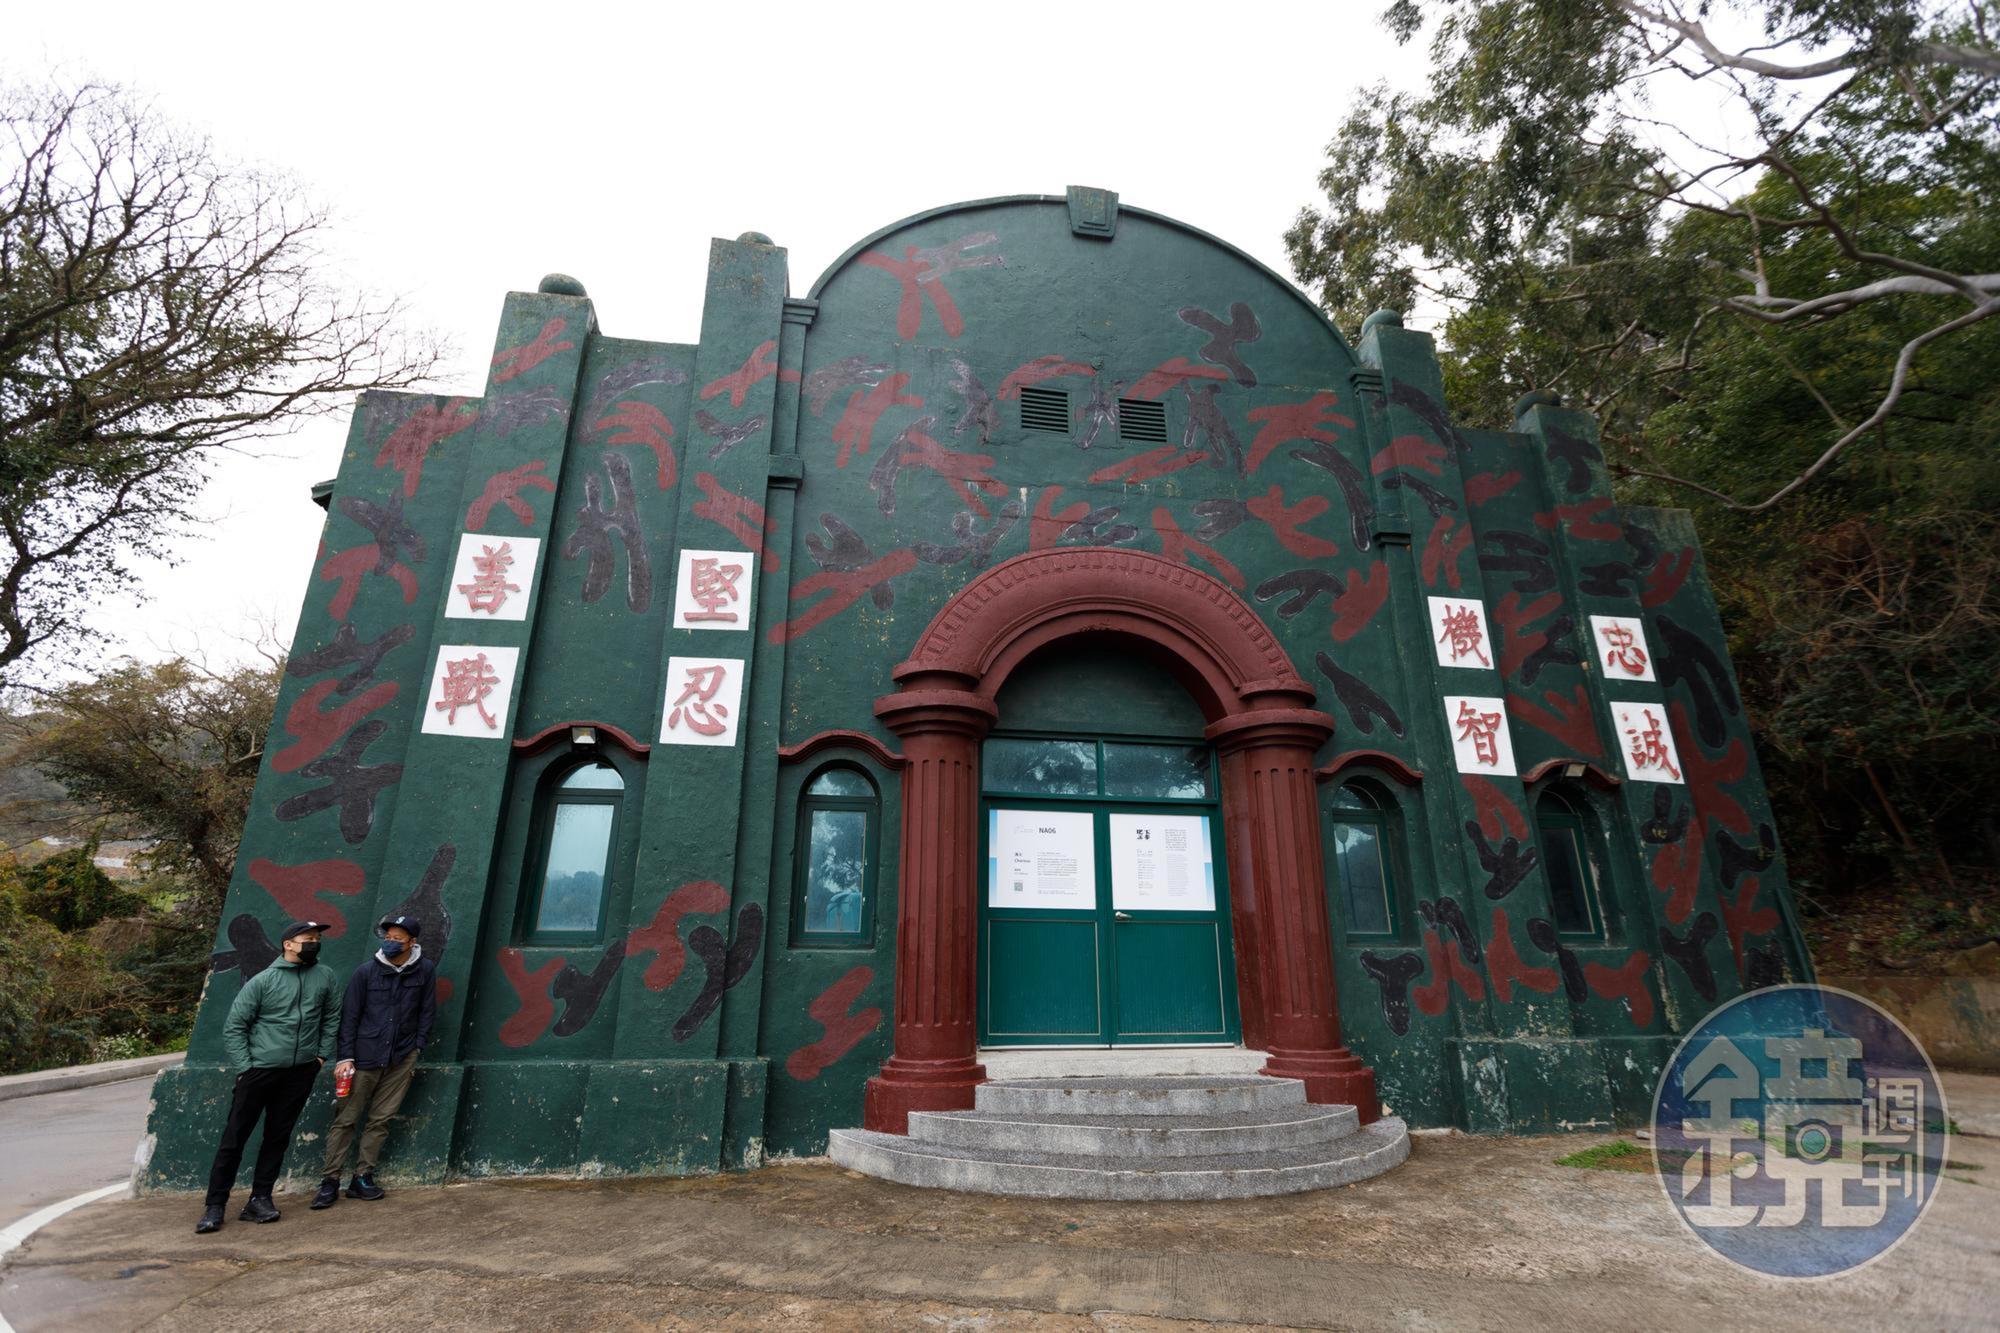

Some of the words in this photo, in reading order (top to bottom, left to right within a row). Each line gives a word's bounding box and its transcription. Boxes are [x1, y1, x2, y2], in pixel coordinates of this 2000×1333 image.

[435, 541, 520, 731] 善戰
[668, 558, 744, 738] 堅忍
[1439, 603, 1501, 767] 機智
[1599, 620, 1680, 781] 忠誠
